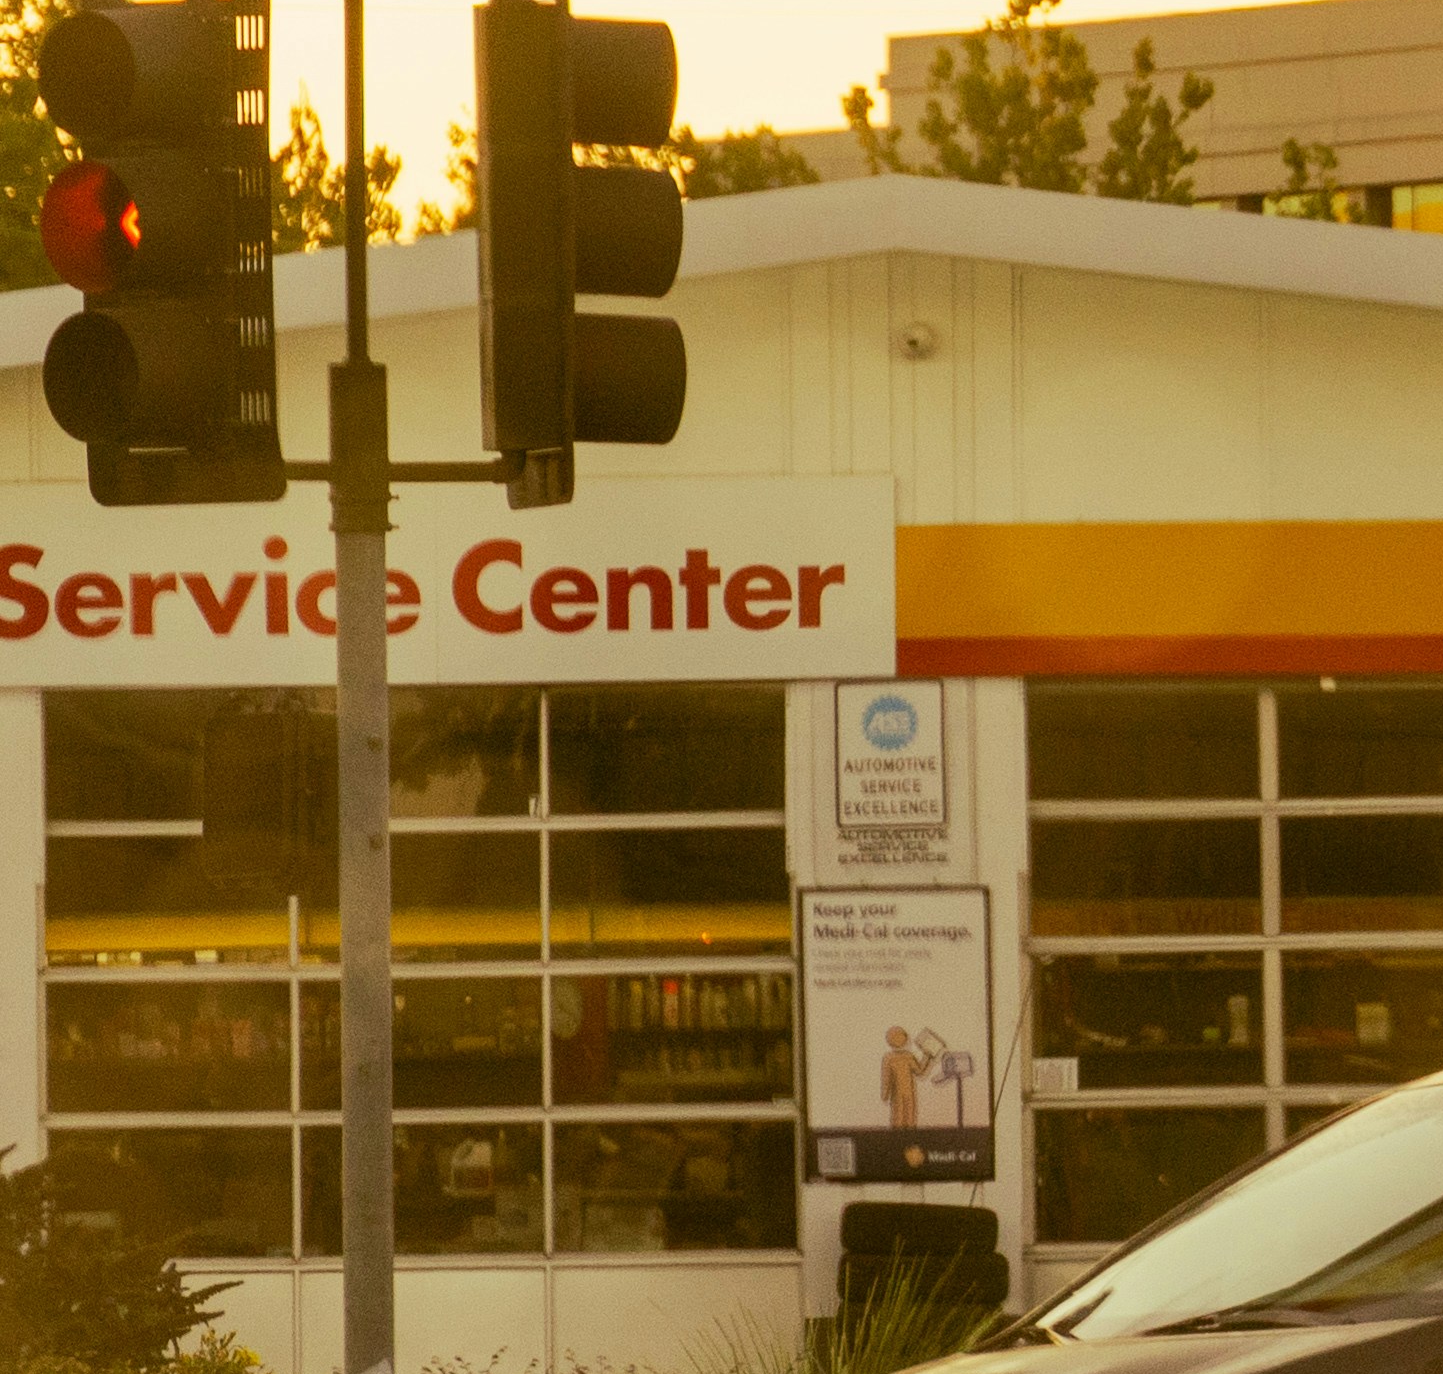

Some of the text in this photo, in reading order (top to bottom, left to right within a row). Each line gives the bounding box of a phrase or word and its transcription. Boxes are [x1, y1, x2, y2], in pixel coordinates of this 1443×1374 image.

[451, 536, 847, 635] Center
[843, 756, 937, 773] AUTOMOTIVE
[859, 778, 922, 794] SERVICE
[843, 800, 939, 817] EXCELLENCE
[838, 828, 949, 841] AUTOMOTIVE
[837, 852, 949, 865] EXCELLENCE
[812, 902, 898, 919] Keep your
[812, 922, 889, 940] Medi-Cal
